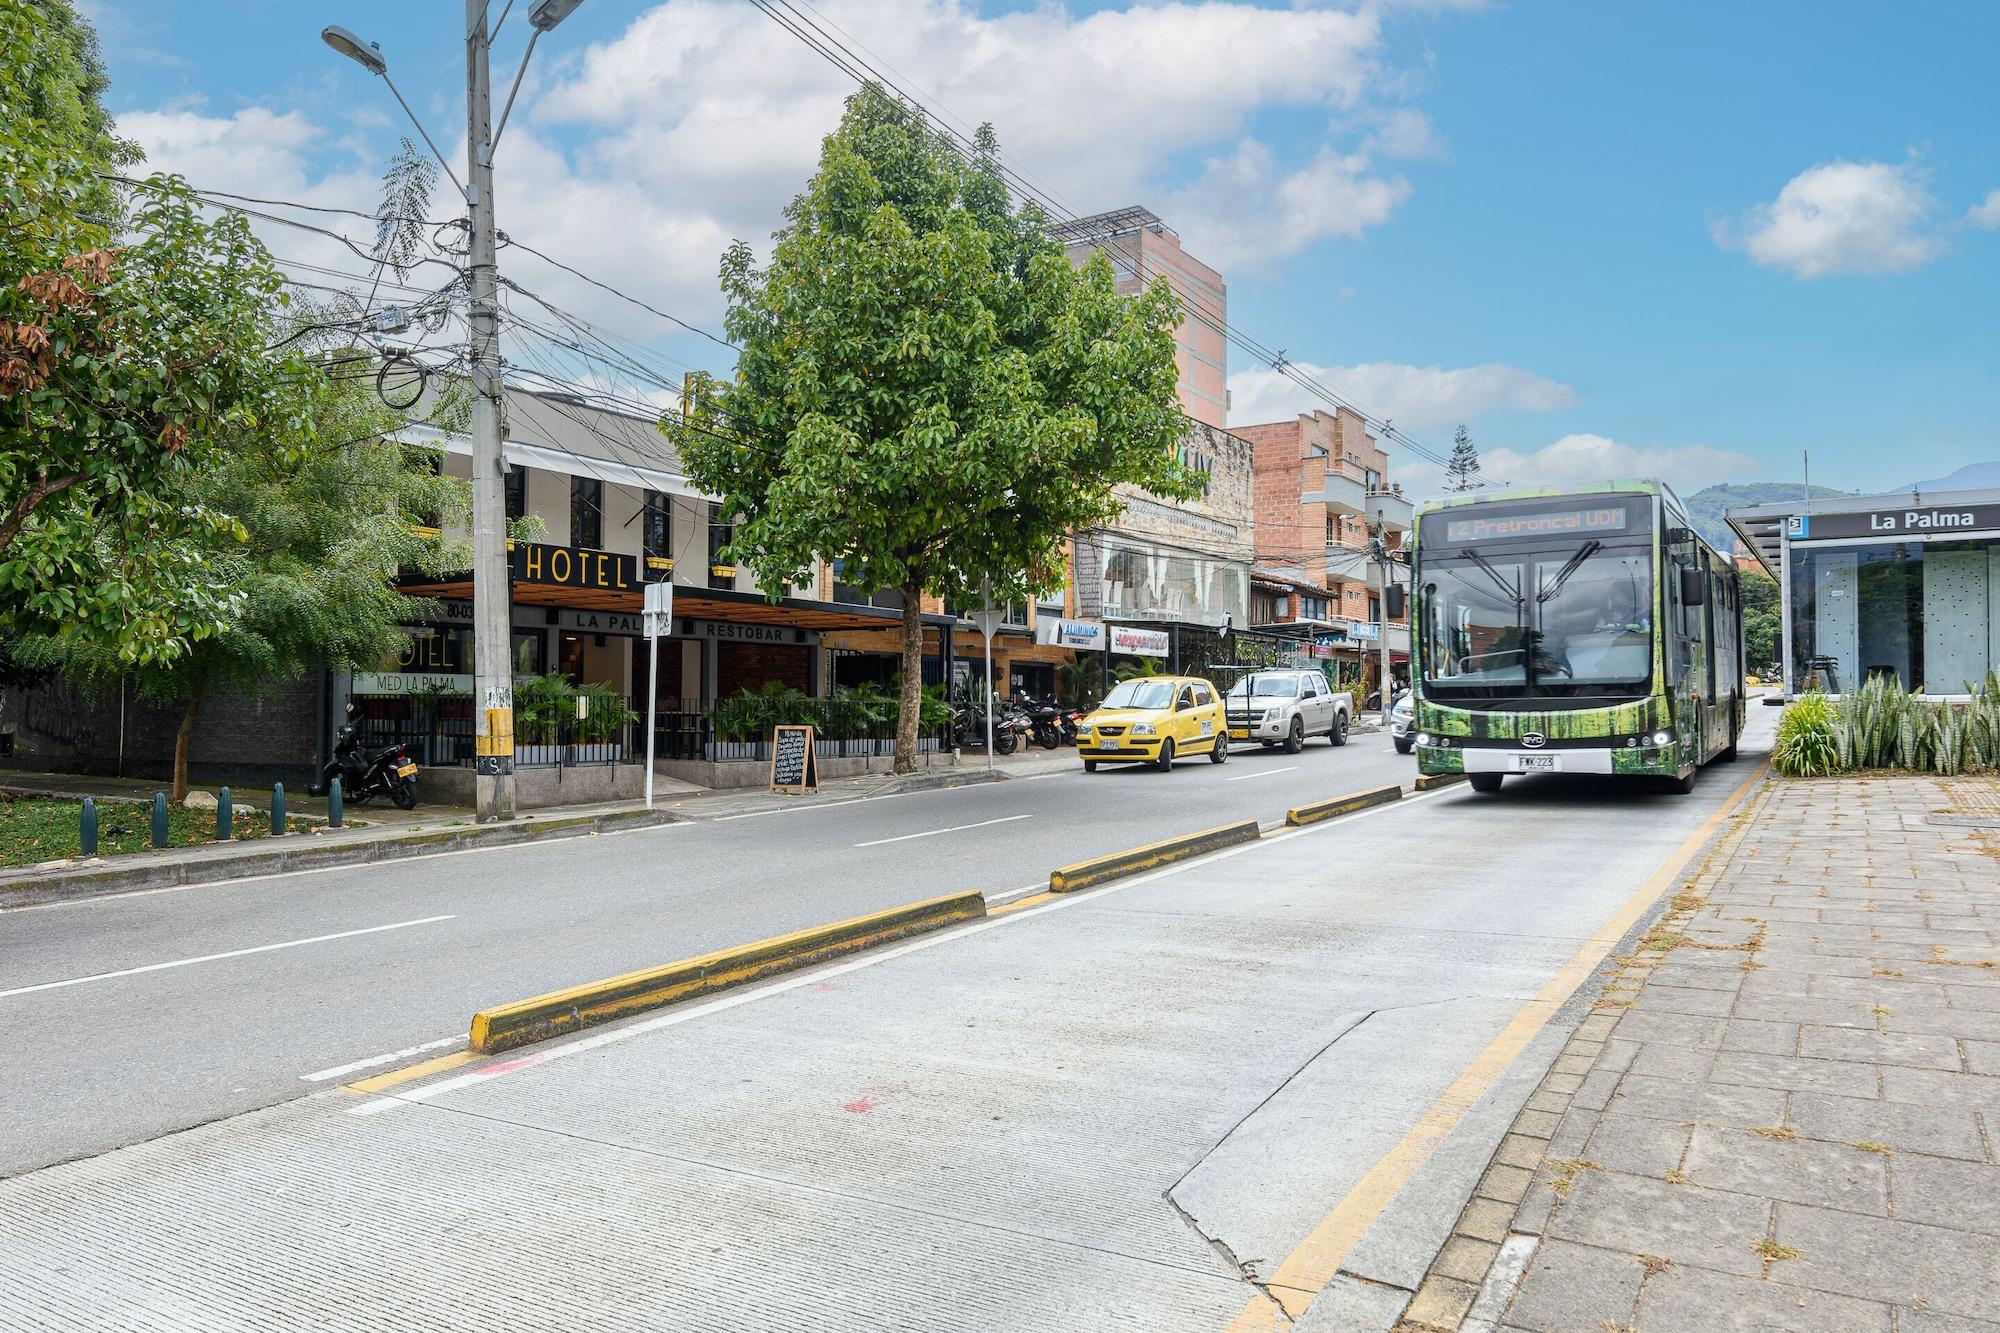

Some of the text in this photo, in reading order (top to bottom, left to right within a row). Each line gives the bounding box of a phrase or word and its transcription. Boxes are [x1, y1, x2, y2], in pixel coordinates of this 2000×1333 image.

[1871, 511, 1975, 530] La Palma
[526, 547, 628, 588] HOTEL
[577, 614, 599, 628] LA
[707, 624, 783, 641] RESTOBAR
[390, 632, 454, 667] OTEL
[377, 676, 401, 690] MED
[407, 676, 417, 690] LA
